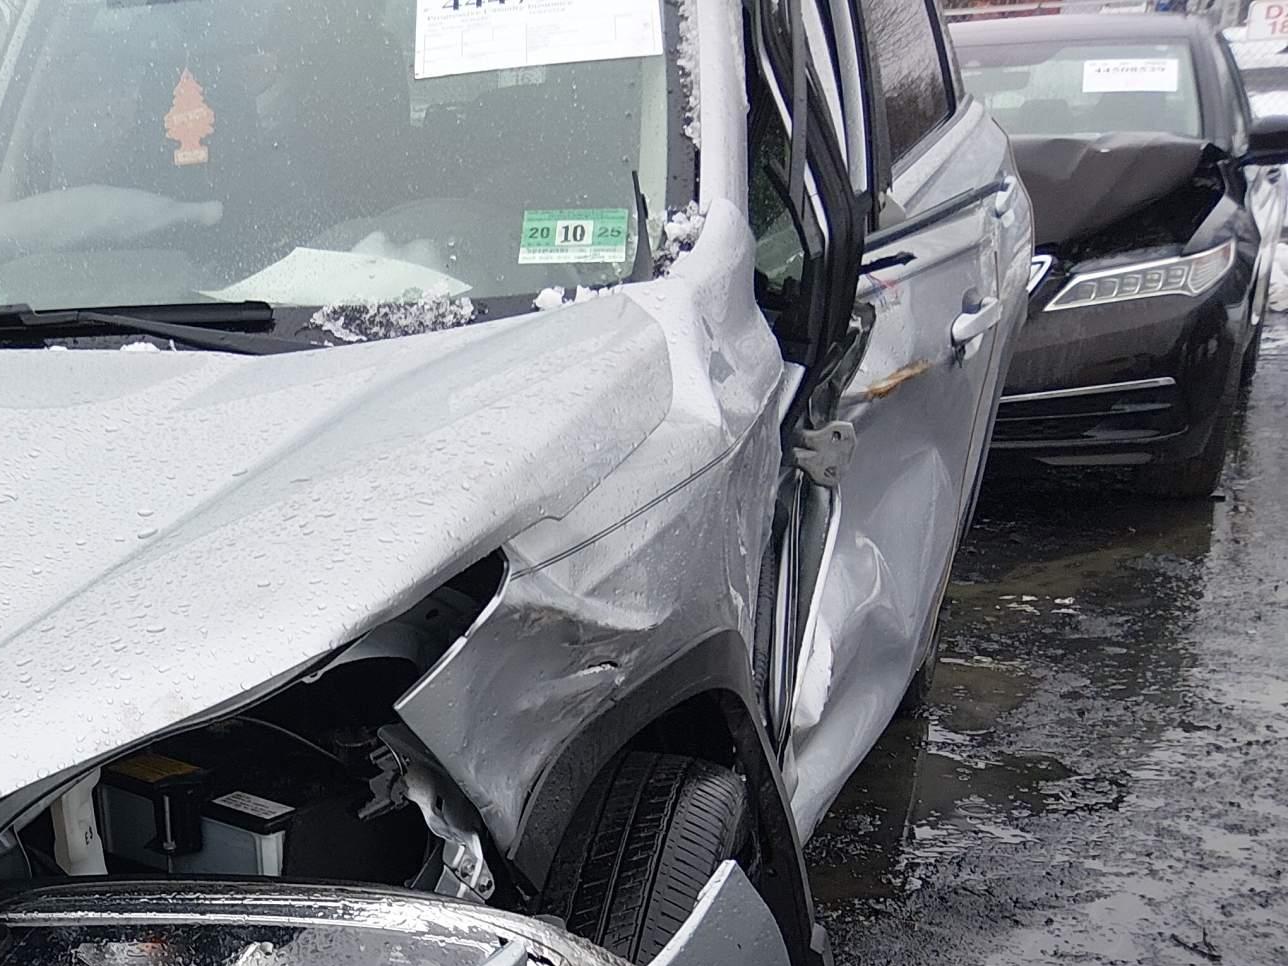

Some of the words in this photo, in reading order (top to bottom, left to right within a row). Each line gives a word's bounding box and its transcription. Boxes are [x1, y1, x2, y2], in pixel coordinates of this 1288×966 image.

[528, 226, 551, 239] 20
[560, 224, 586, 244] 10
[597, 226, 622, 238] 25
